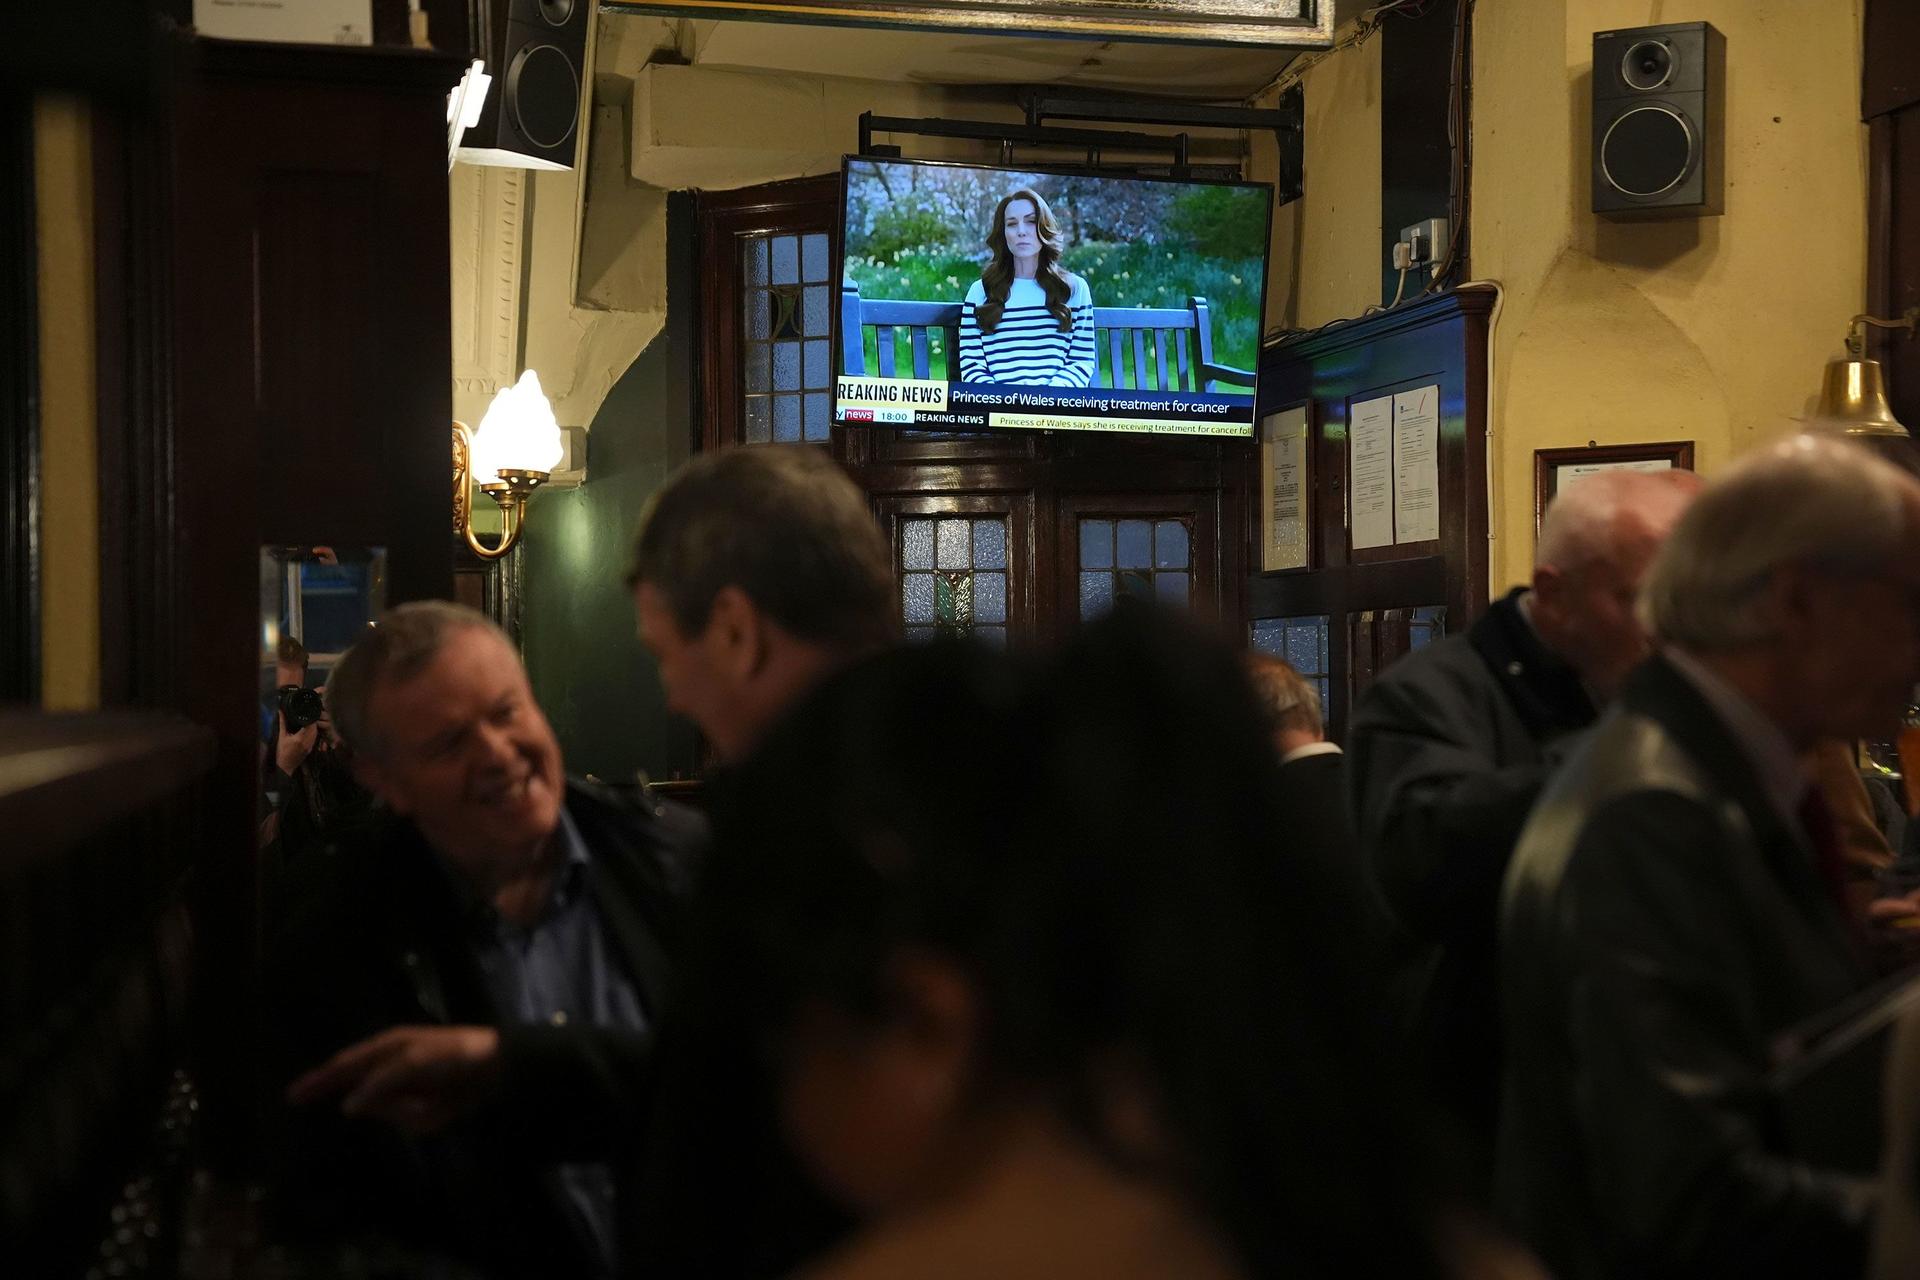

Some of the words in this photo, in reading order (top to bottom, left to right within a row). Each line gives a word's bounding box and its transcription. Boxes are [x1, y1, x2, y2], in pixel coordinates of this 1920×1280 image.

[838, 383, 898, 402] REAKING
[902, 386, 942, 404] NEWS
[952, 390, 1002, 404] Princess
[1004, 392, 1018, 405] of
[1019, 393, 1055, 406] Wales
[1057, 396, 1109, 411] receiving
[1110, 398, 1170, 411] treatment
[1172, 400, 1189, 412] for
[1190, 402, 1230, 414] cancer
[846, 411, 873, 419] news
[881, 412, 908, 421] 18:00
[915, 413, 956, 423] REAKING
[957, 415, 984, 424] NEWS
[1000, 417, 1034, 427] Princess
[1036, 418, 1045, 427] of
[1046, 420, 1071, 428] Wales
[1092, 421, 1108, 429] she
[1117, 424, 1154, 432] receiving
[1155, 424, 1196, 432] treatment
[1197, 425, 1211, 433] for
